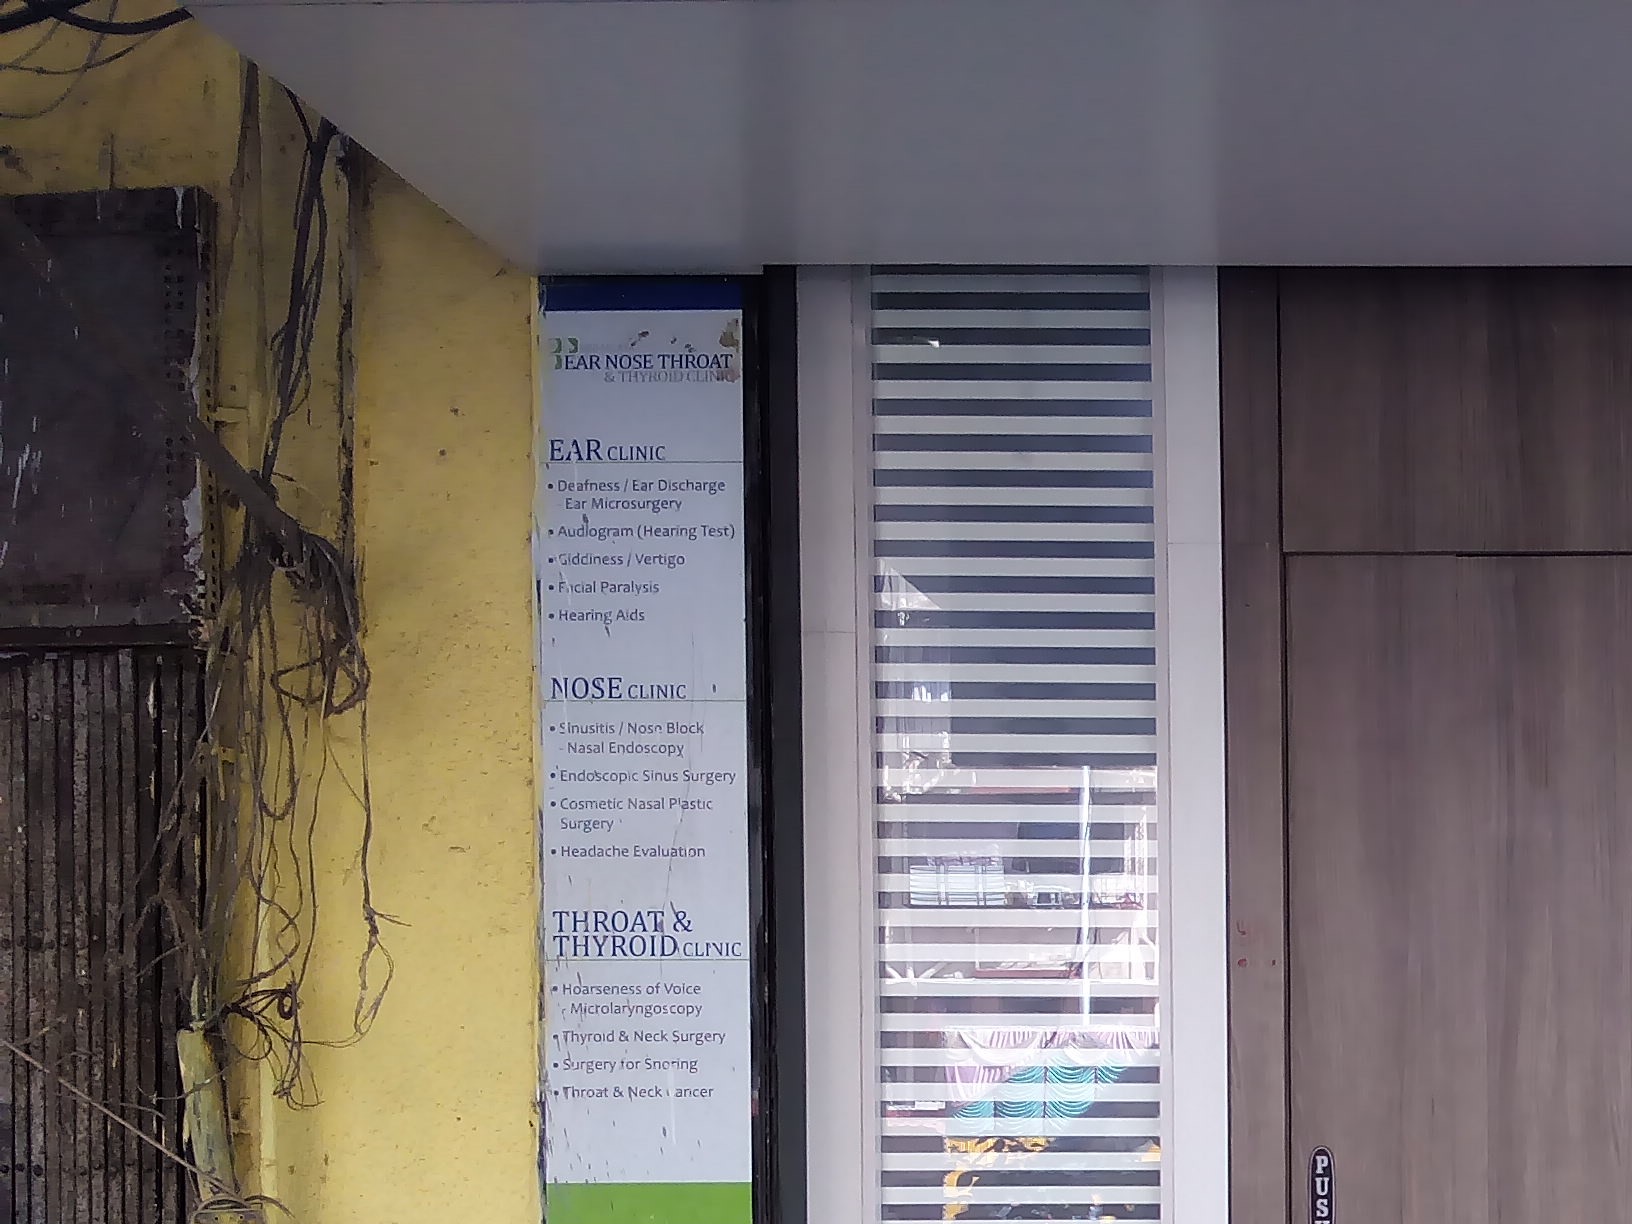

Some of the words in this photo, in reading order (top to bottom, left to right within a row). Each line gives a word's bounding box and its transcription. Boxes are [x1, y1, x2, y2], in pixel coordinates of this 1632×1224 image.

[565, 355, 600, 369] EAR
[606, 355, 653, 369] NOSE
[658, 354, 733, 368] THROAT
[604, 371, 614, 382] &
[620, 371, 682, 382] THYROID
[686, 370, 740, 383] CLINI
[550, 440, 603, 461] EAR
[608, 446, 665, 460] CLINIC
[558, 479, 620, 491] Deafness
[633, 480, 654, 491] Ear
[658, 480, 725, 495] Discharge
[566, 498, 587, 509] Ear
[591, 498, 682, 512] Microsurgery
[559, 525, 633, 540] Audiogram
[638, 525, 697, 540] (Hearing
[701, 524, 735, 539] Test)
[559, 553, 623, 565] Giddiness
[635, 553, 685, 568] Vertigo
[601, 581, 659, 595] Paralysis
[559, 609, 612, 624] Hearing
[616, 609, 645, 621] Aids
[551, 677, 622, 699] NOSE
[628, 685, 686, 699] CLINIC
[559, 722, 615, 734] Sinusitis
[667, 722, 704, 734] Block
[568, 742, 604, 753] Nasal
[609, 742, 684, 757] Endoscopy
[560, 770, 639, 784] Endoscopic
[643, 770, 678, 781] Sinus
[683, 770, 736, 785] Surgery
[560, 798, 623, 810] Cosmetic
[628, 798, 665, 810] Nasal
[669, 798, 713, 810] Plastic
[561, 818, 614, 833] Surgery
[561, 845, 629, 857] Headache
[633, 845, 705, 857] Evaluation
[553, 911, 664, 932] THROAT
[673, 911, 692, 932] &
[553, 935, 678, 957] THYROID
[683, 942, 742, 956] CLINIC
[562, 983, 642, 994] Hoarseness
[646, 982, 660, 994] of
[664, 983, 701, 994] Voice
[570, 1002, 702, 1017] Microlaryngoscopy
[563, 1030, 615, 1044] Thyroid
[619, 1031, 629, 1042] &
[634, 1030, 668, 1042] Neck
[673, 1030, 726, 1045] Surgery
[563, 1058, 616, 1073] Surgery
[620, 1058, 640, 1070] for
[645, 1058, 698, 1073] Snoring
[563, 1086, 608, 1098] Throat
[613, 1086, 624, 1097] &
[628, 1086, 662, 1098] Neck
[666, 1086, 714, 1098] ancer
